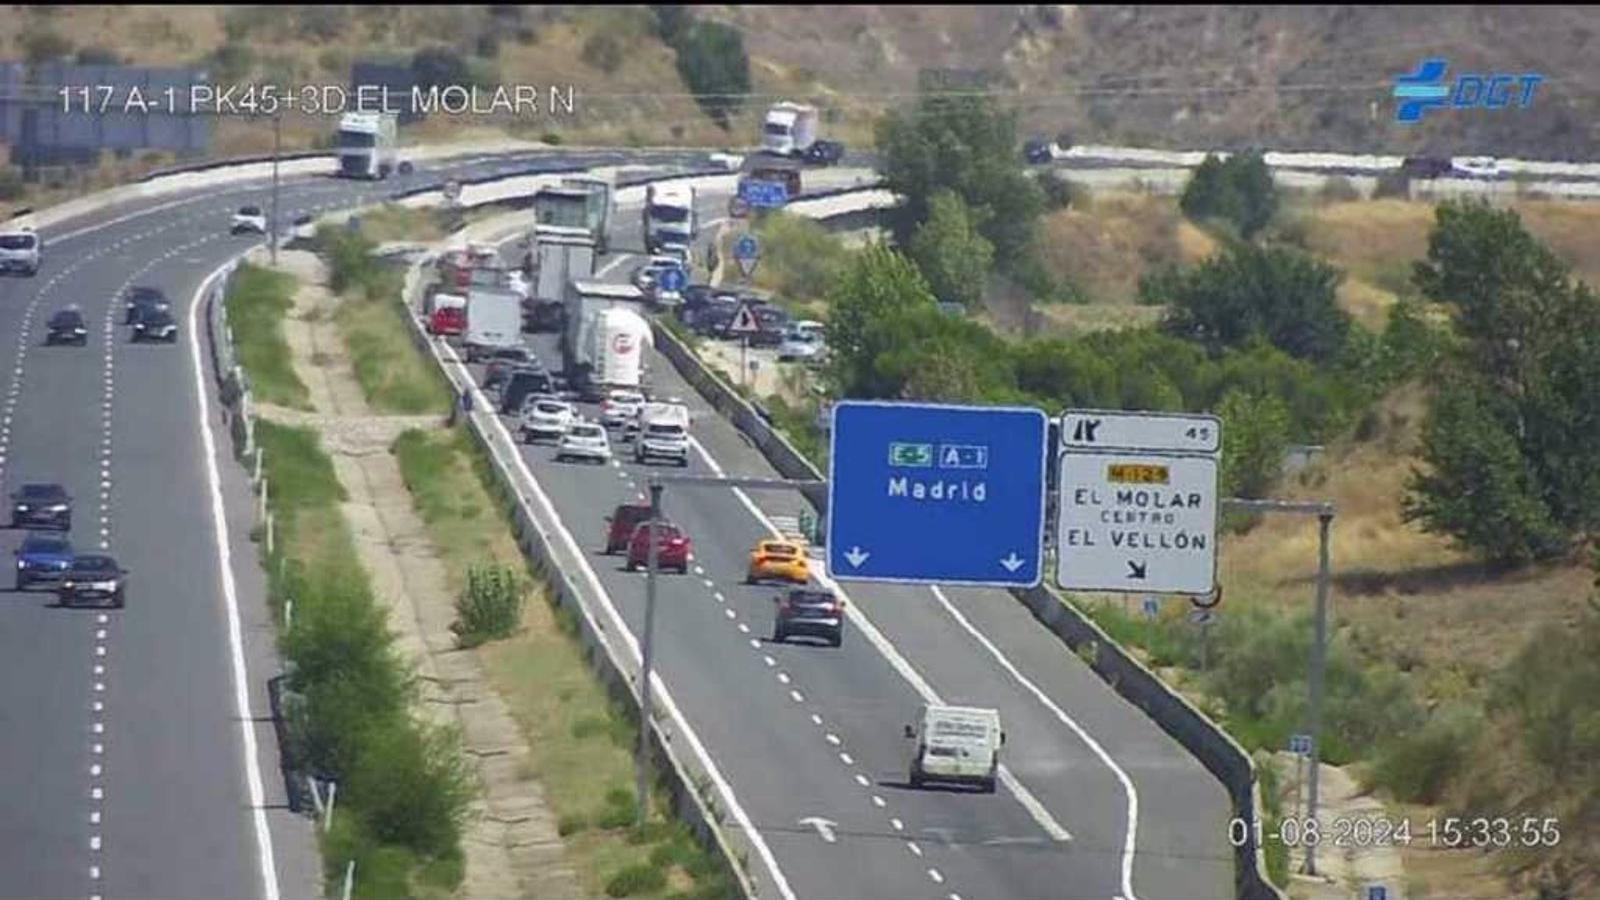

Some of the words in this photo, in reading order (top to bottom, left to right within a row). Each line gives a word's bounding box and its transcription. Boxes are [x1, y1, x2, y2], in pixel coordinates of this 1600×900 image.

[894, 446, 929, 463] E-5
[945, 448, 984, 464] A-1
[888, 476, 986, 501] Madrid
[1075, 488, 1101, 505] EL
[1116, 490, 1201, 508] MOLAR
[1101, 510, 1175, 525] CENTRO
[1068, 529, 1095, 546] EL
[1111, 529, 1206, 550] VELLÓN
